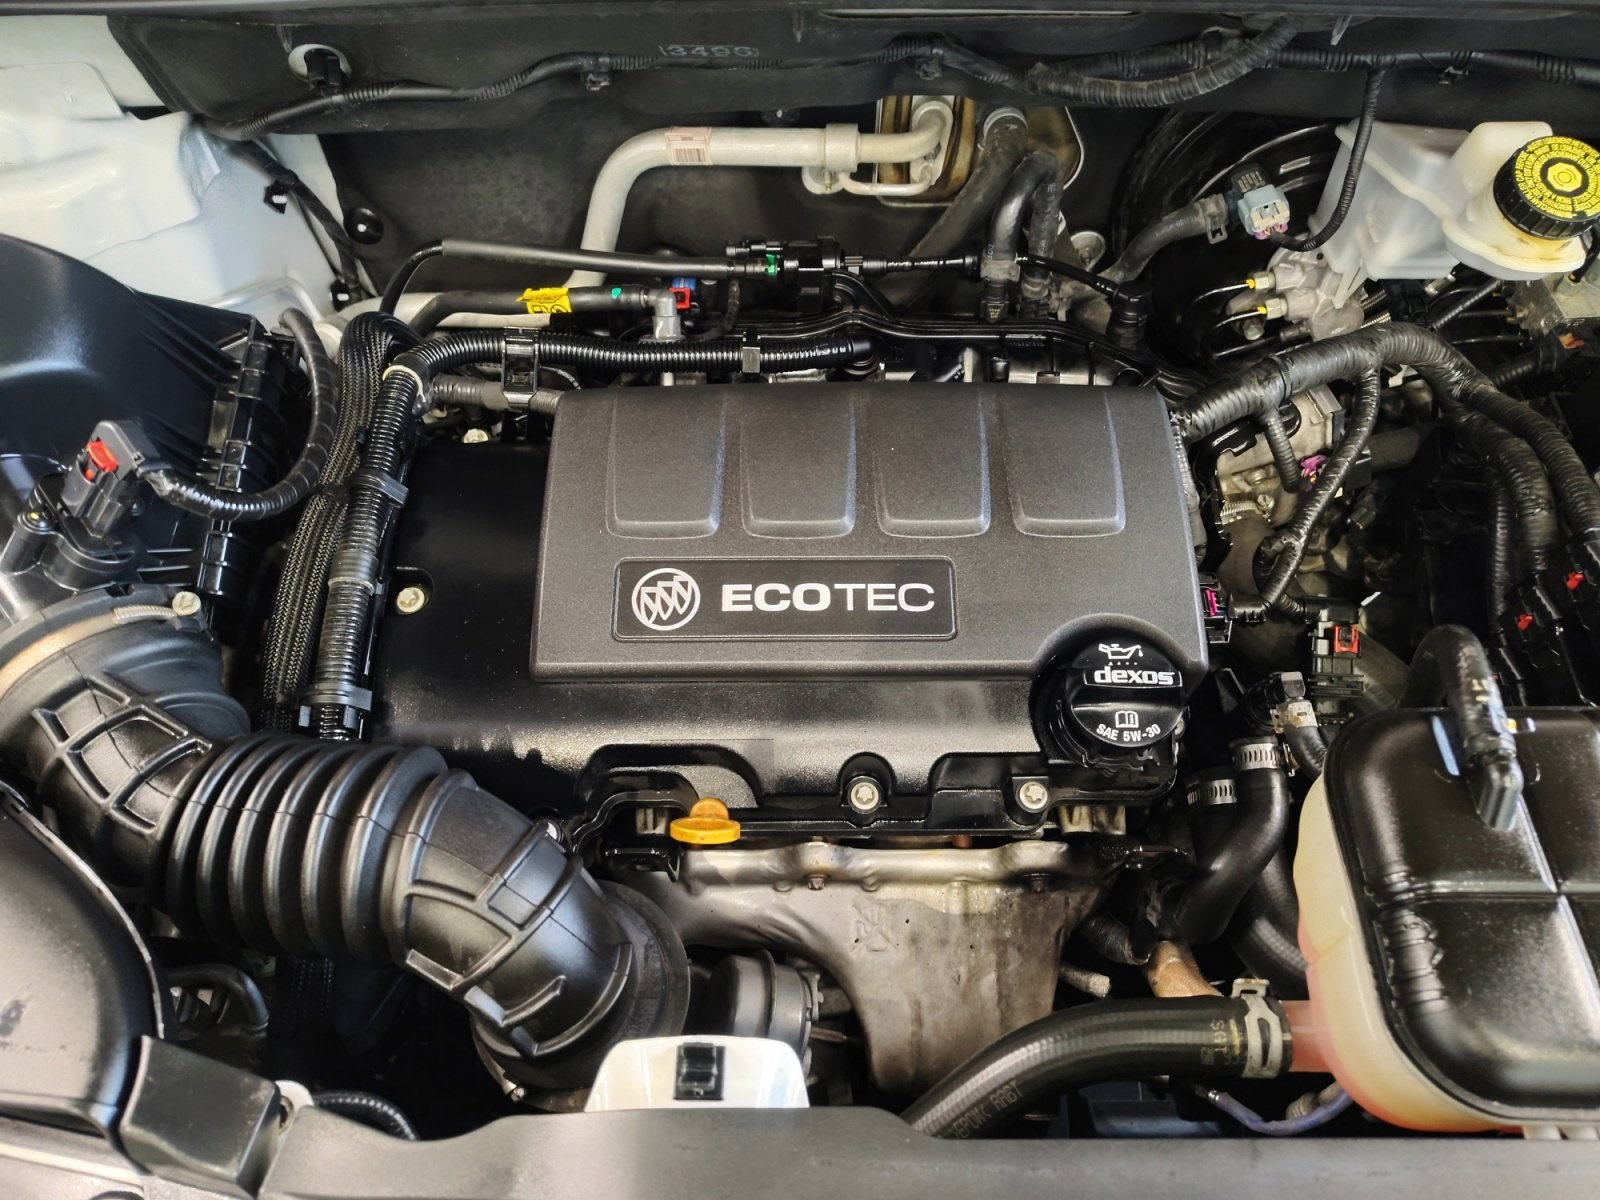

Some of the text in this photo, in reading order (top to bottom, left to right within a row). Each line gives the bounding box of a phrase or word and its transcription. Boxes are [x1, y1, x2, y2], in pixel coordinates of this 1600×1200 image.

[721, 583, 935, 612] ECOTEC
[1094, 666, 1175, 685] dexos
[1096, 723, 1161, 742] SAE 5W-30
